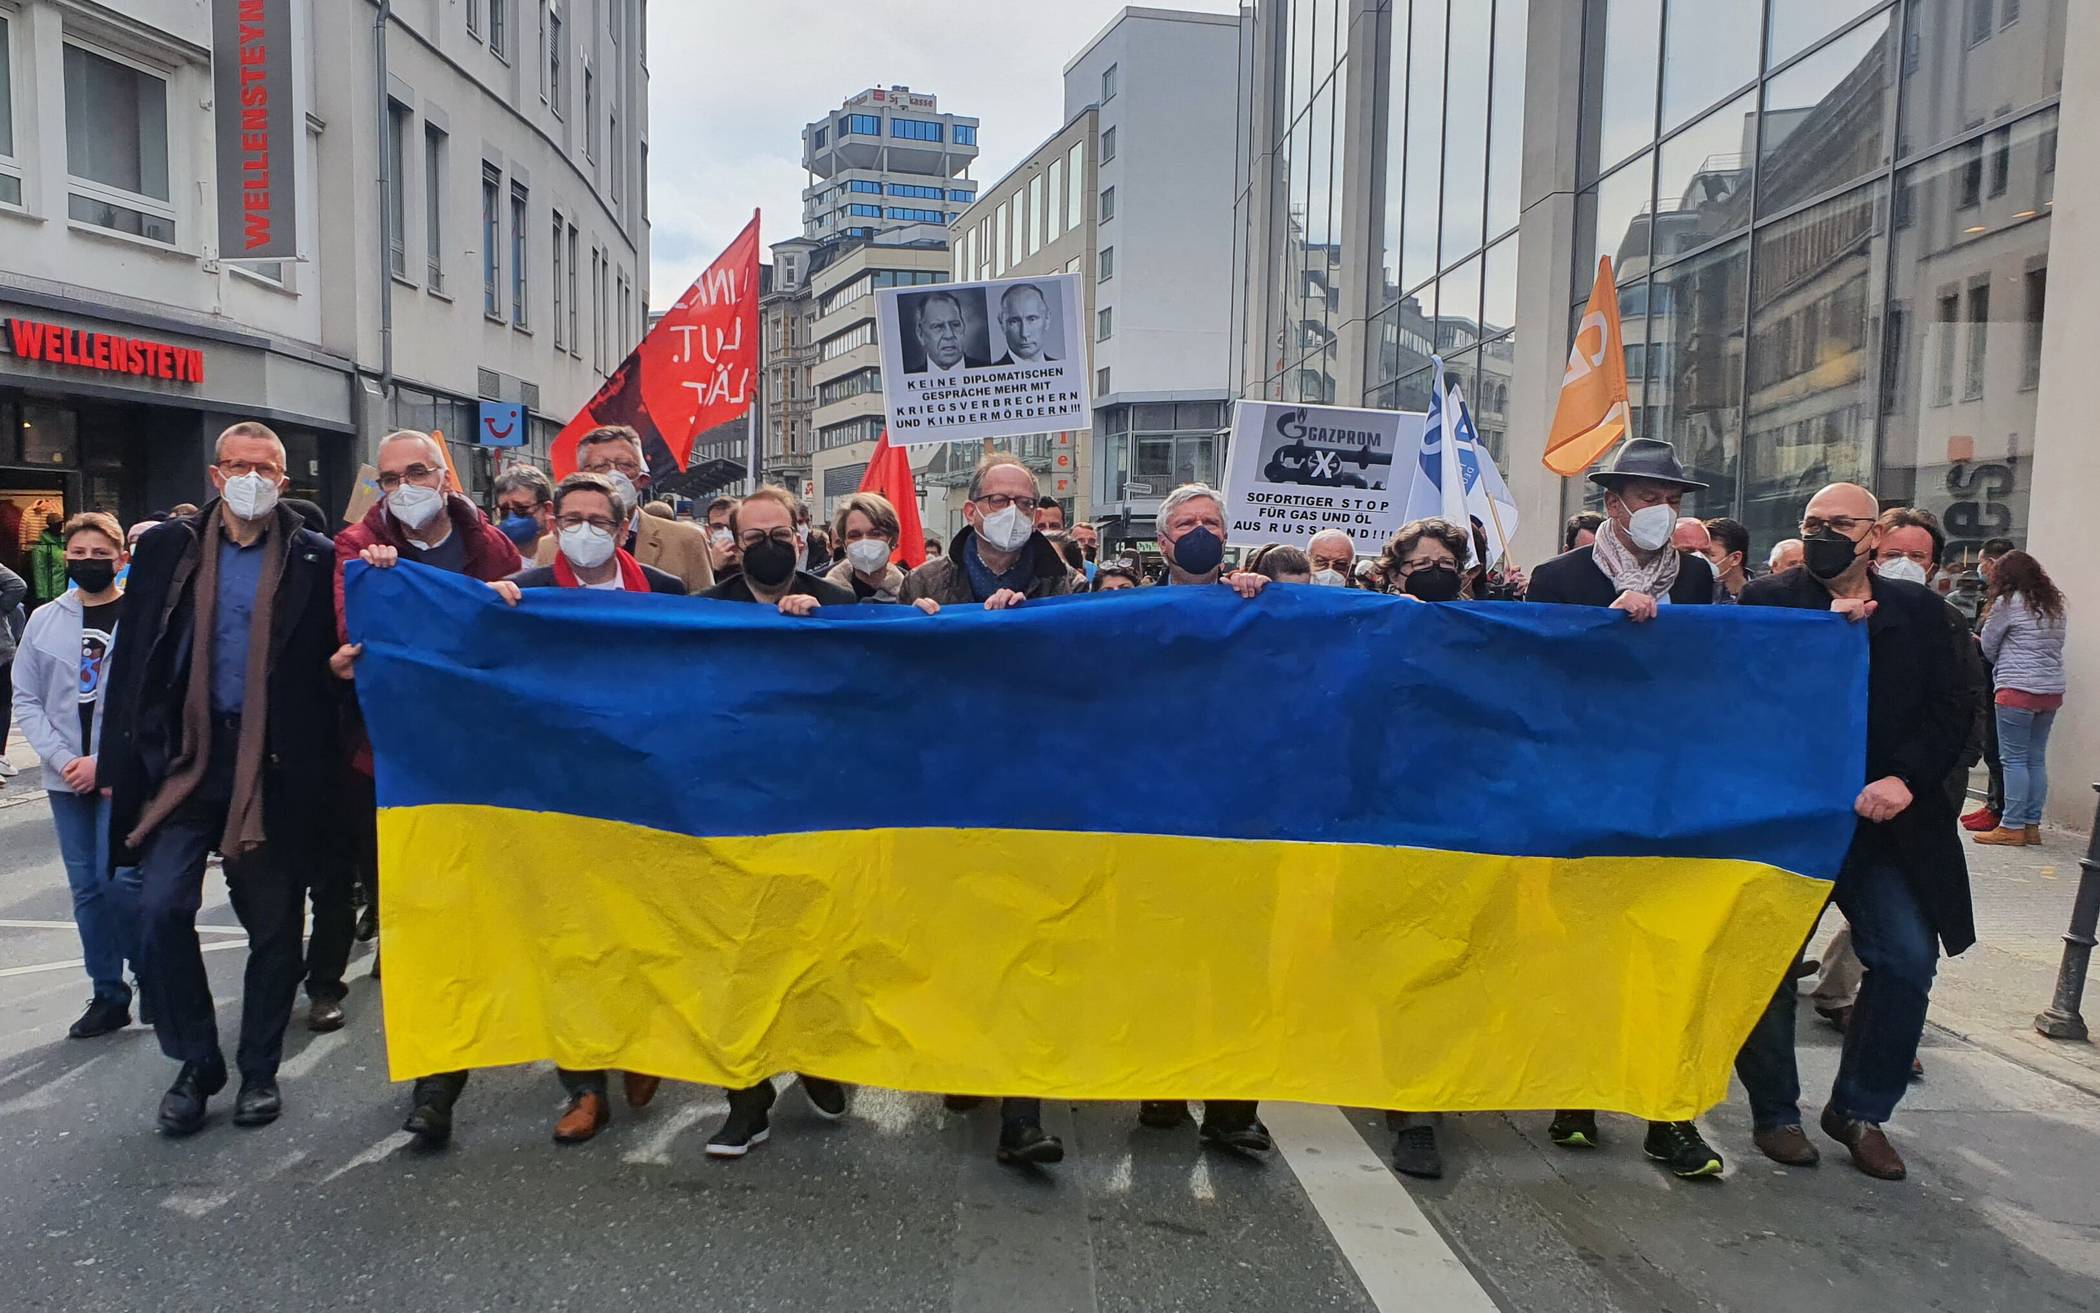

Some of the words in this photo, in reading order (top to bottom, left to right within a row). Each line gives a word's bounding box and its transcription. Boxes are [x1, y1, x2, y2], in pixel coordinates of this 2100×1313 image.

[239, 0, 271, 250] WELLENSTEYN
[10, 318, 205, 384] WELLENSTEYN
[907, 377, 957, 390] KEINE
[963, 367, 1064, 385] DIPLOMATISCHEN
[922, 386, 991, 401] GESPRÄCHE
[994, 383, 1028, 394] MEHR
[1030, 381, 1052, 391] MIT
[896, 391, 1078, 416] KRIEGSVERBRECHERN
[896, 418, 921, 429] UND
[927, 404, 1081, 426] KINDERMÖRDERN!!!
[1308, 426, 1382, 447] GAZPROM
[1247, 492, 1333, 507] SOFORTIGER
[1341, 498, 1389, 511] STOP
[1233, 520, 1261, 531] AUS
[1258, 507, 1286, 519] FÜR
[1290, 509, 1318, 520] GAS
[1322, 512, 1350, 523] UND
[1354, 512, 1372, 525] ÖL
